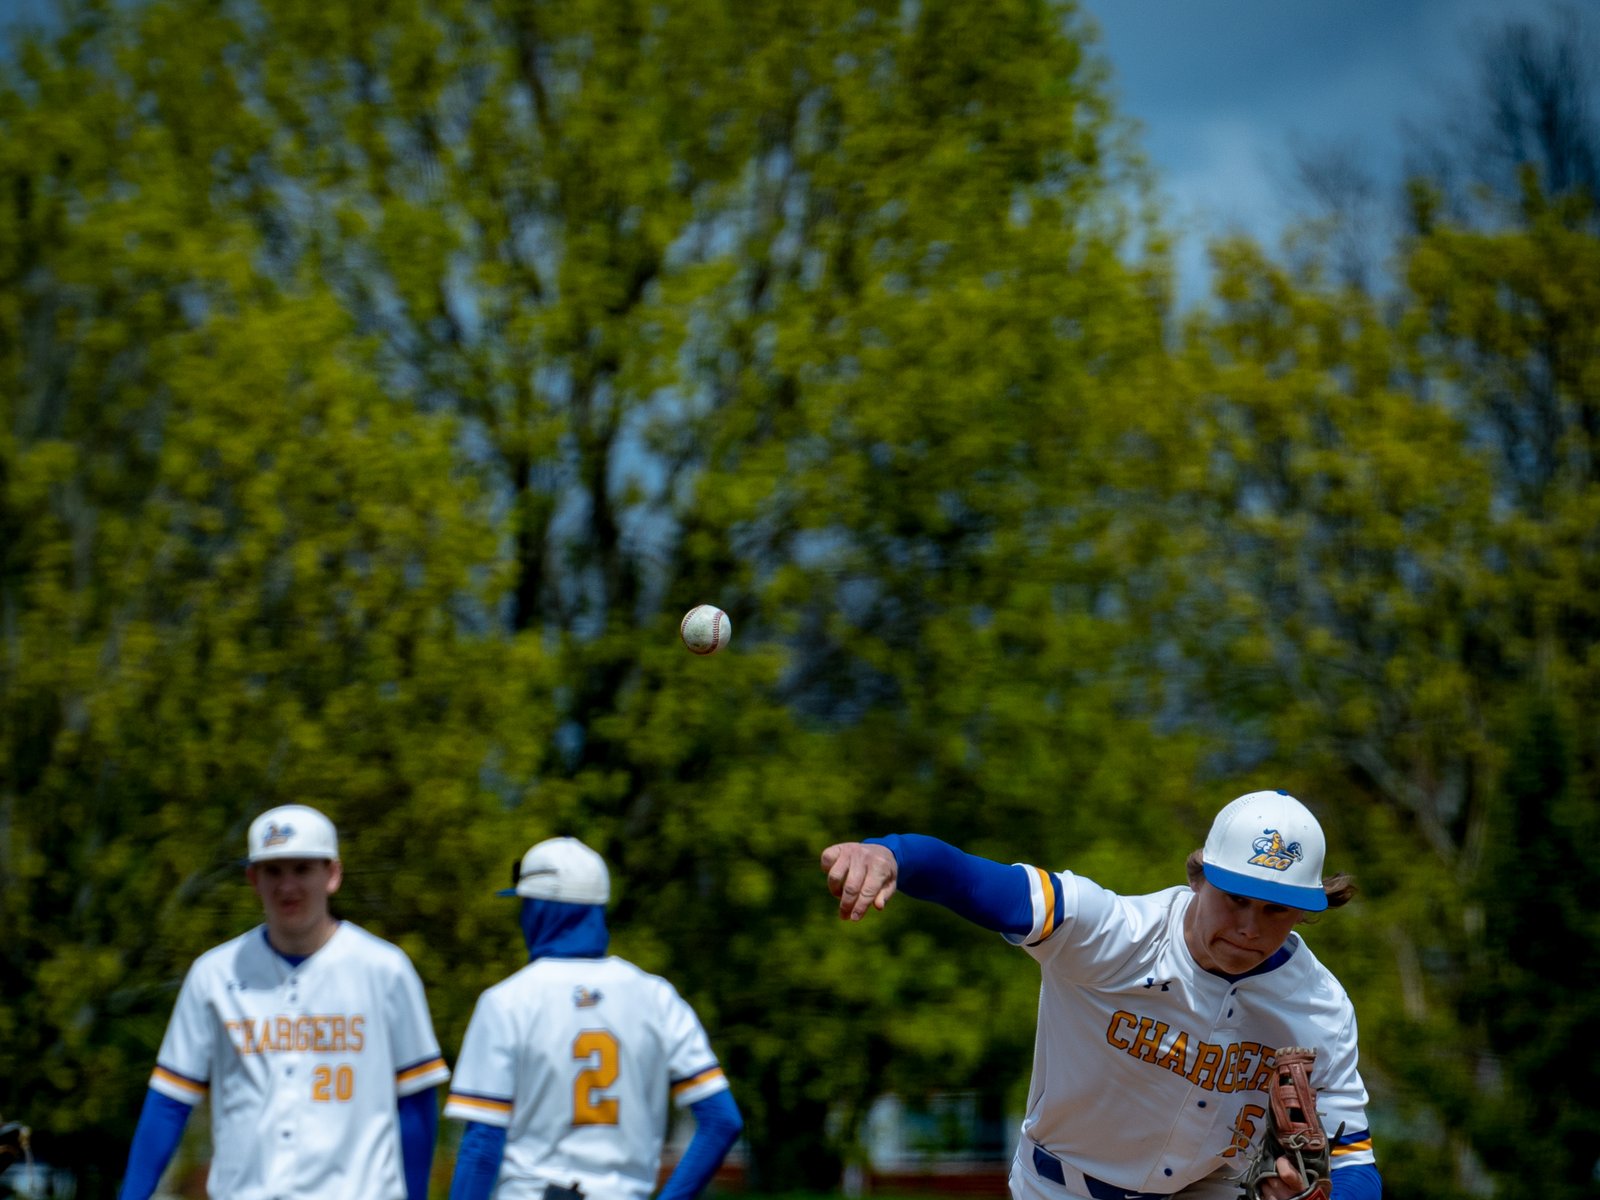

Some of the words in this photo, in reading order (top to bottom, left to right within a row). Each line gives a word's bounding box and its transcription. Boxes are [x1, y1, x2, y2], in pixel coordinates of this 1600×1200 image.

[312, 1064, 355, 1103] 20
[571, 1029, 621, 1126] 2
[1106, 1010, 1277, 1094] CHARGER
